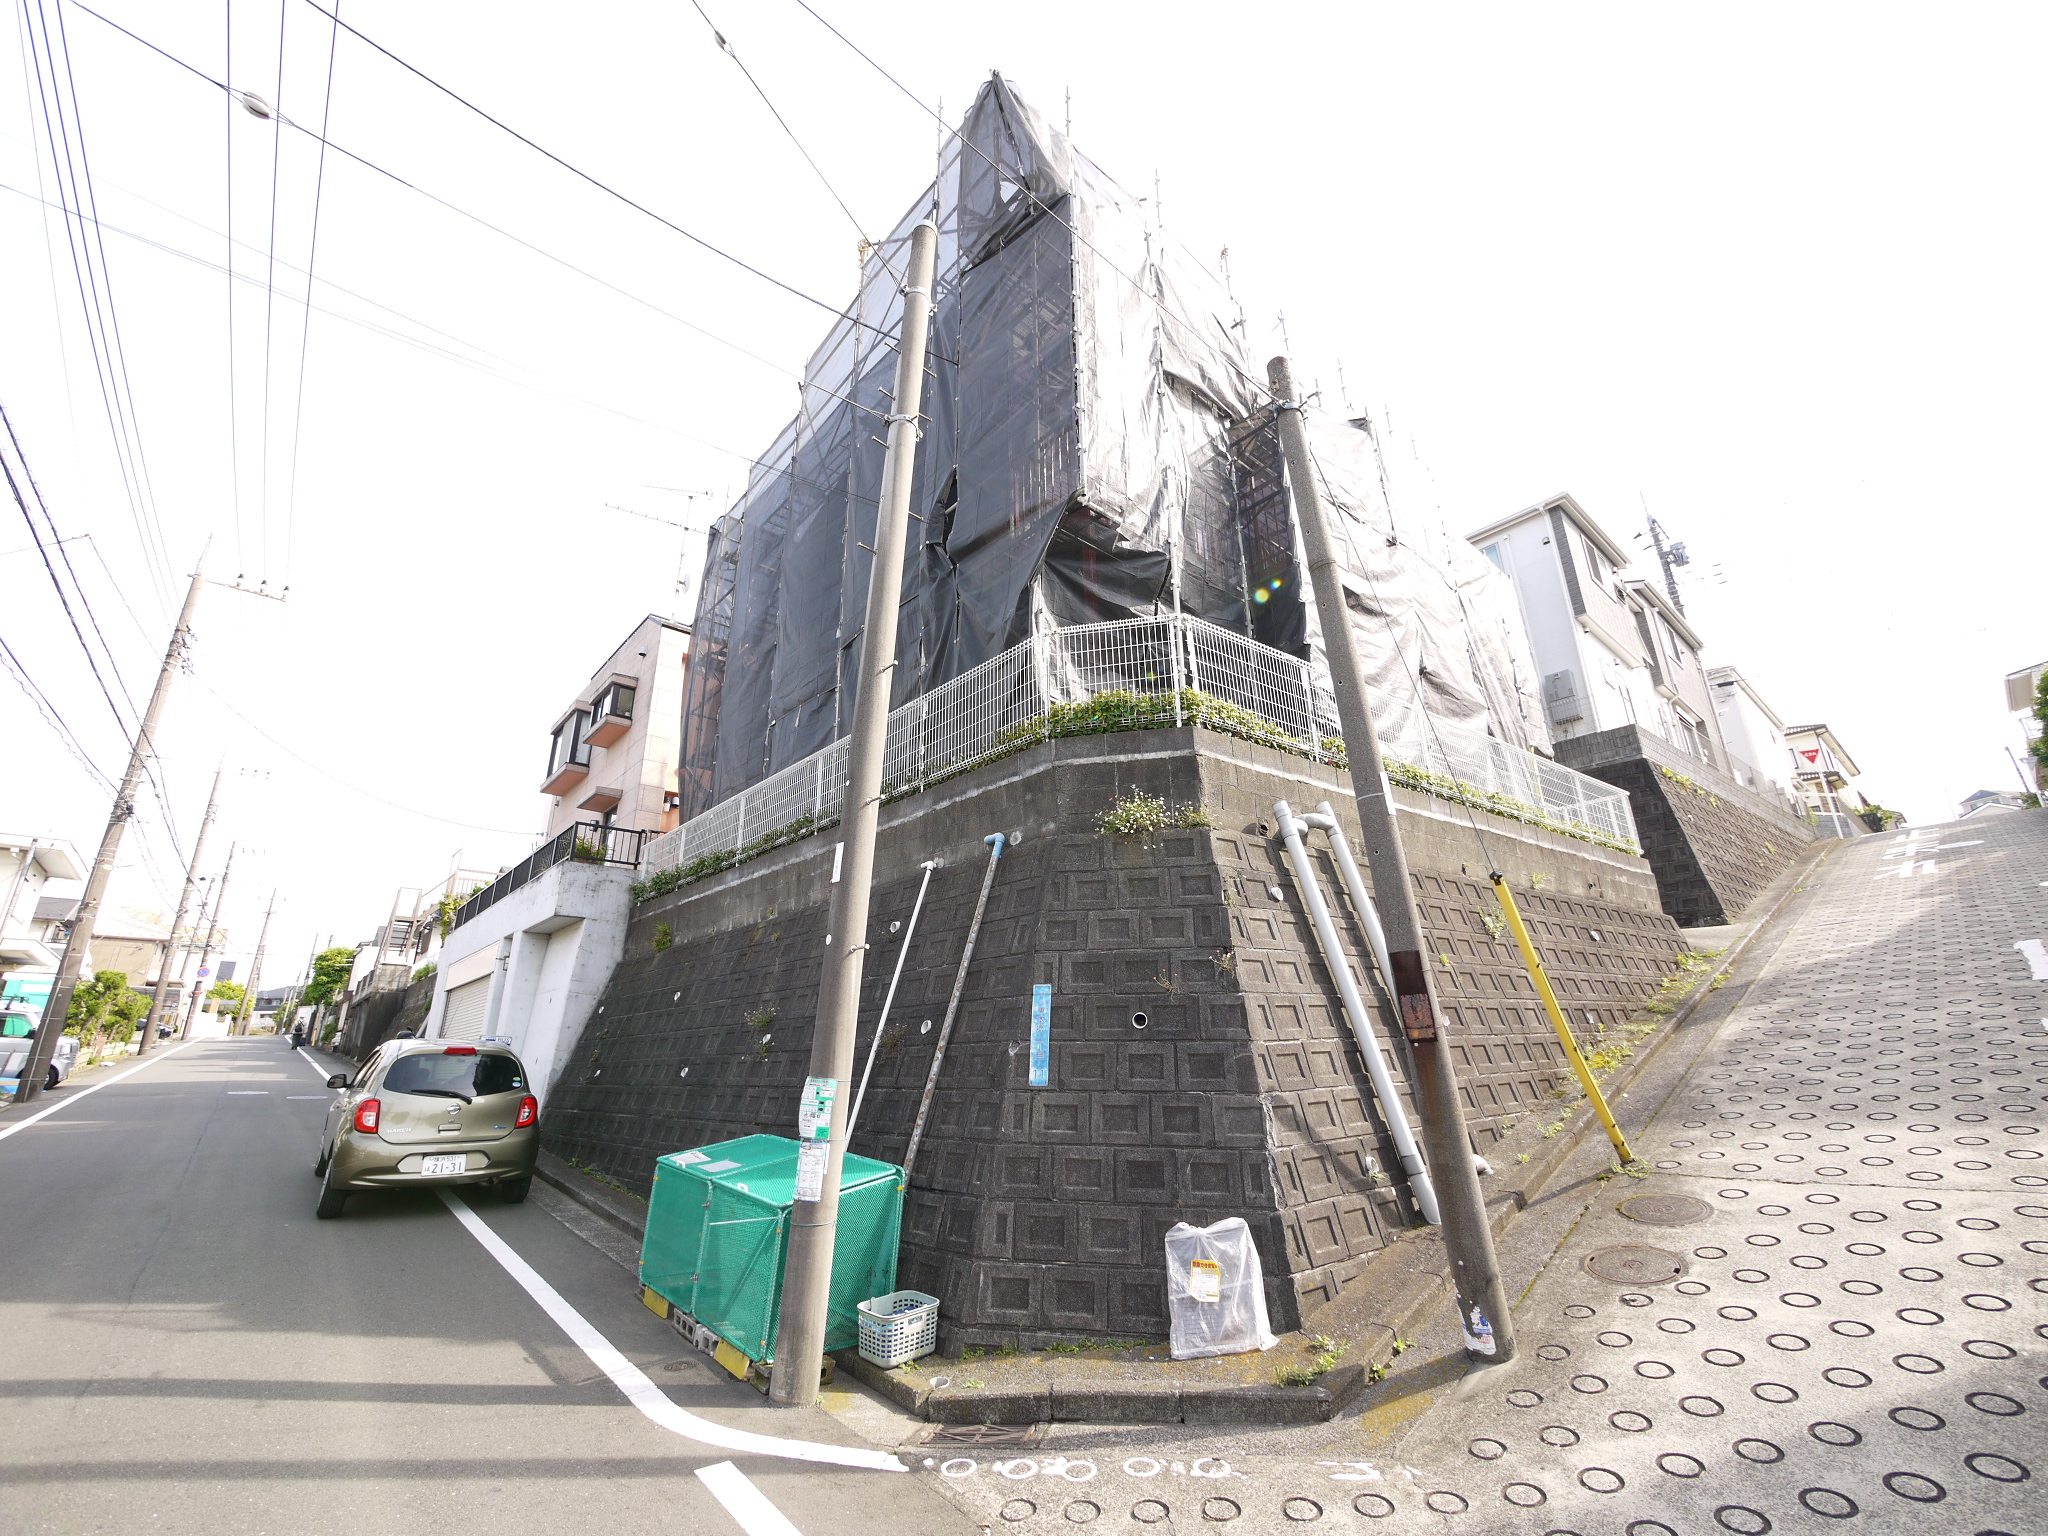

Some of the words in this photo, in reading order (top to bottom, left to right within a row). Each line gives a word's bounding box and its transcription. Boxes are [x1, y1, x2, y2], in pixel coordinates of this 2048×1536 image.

[1873, 829, 1940, 880] 止まれ
[431, 1161, 462, 1174] 21-31
